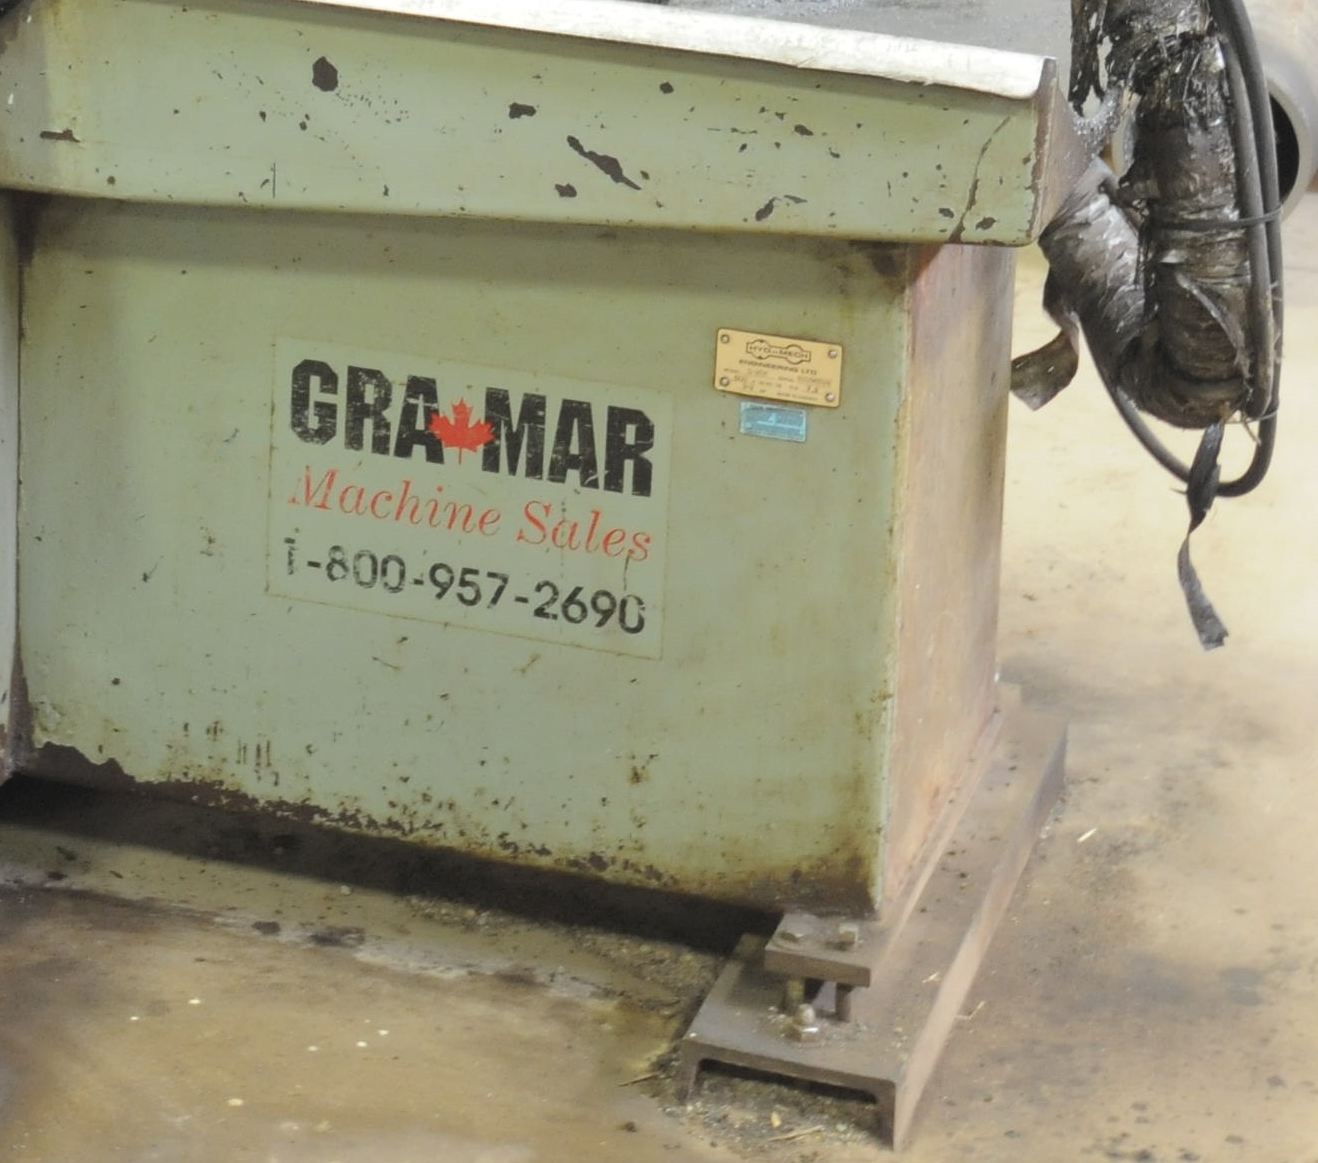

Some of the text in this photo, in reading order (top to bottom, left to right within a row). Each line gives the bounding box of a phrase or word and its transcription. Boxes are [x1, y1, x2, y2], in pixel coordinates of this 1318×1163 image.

[288, 465, 653, 562] Machine Sales
[284, 536, 646, 634] 1-800-957-2690
